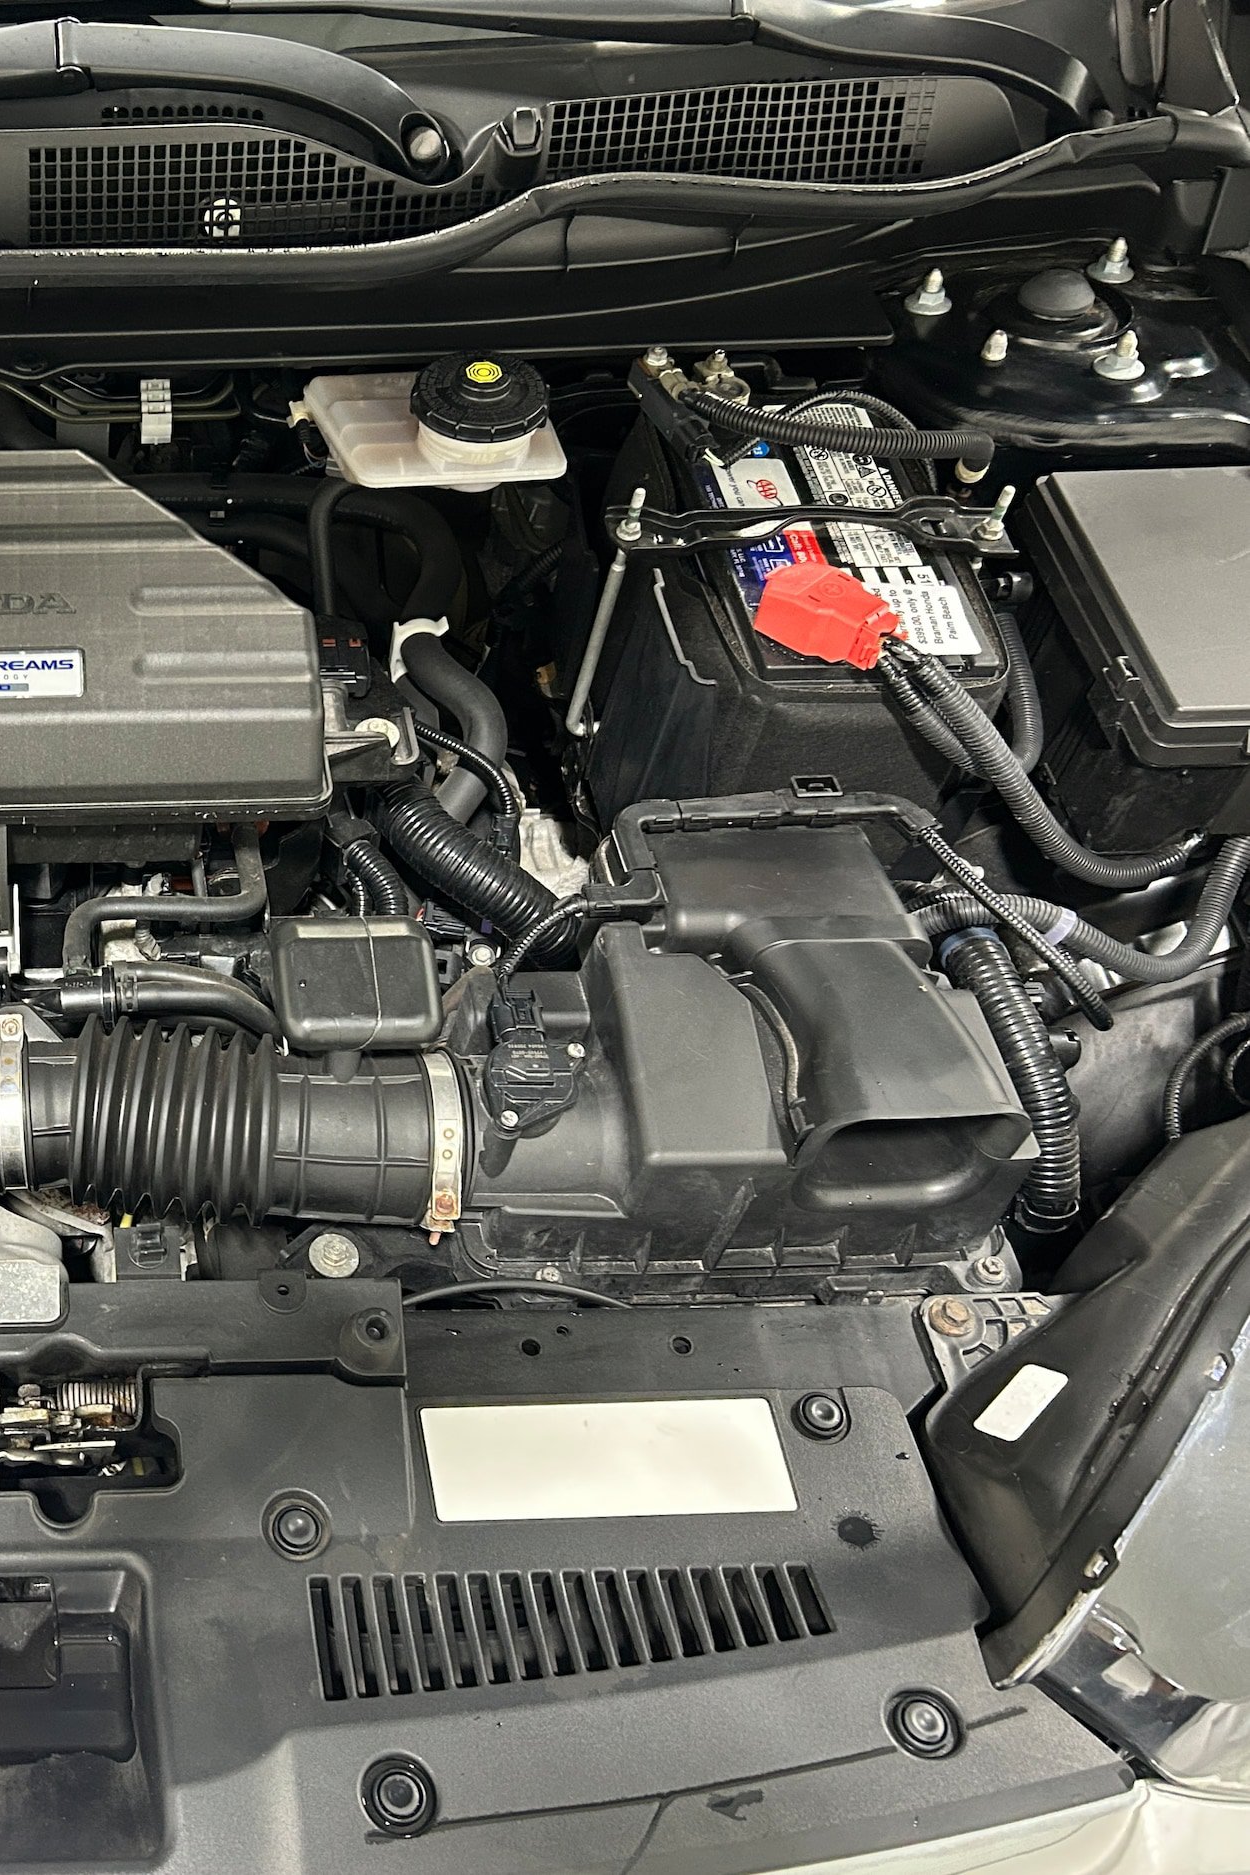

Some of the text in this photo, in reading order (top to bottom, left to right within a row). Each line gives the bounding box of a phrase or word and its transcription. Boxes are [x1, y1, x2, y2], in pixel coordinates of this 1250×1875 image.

[729, 484, 741, 495] you
[759, 479, 777, 499] AAA
[917, 574, 934, 586] 51
[906, 598, 917, 612] only
[920, 591, 943, 644] Braman Honda
[938, 597, 958, 639] Palm Beach
[912, 616, 927, 643] $399.00,
